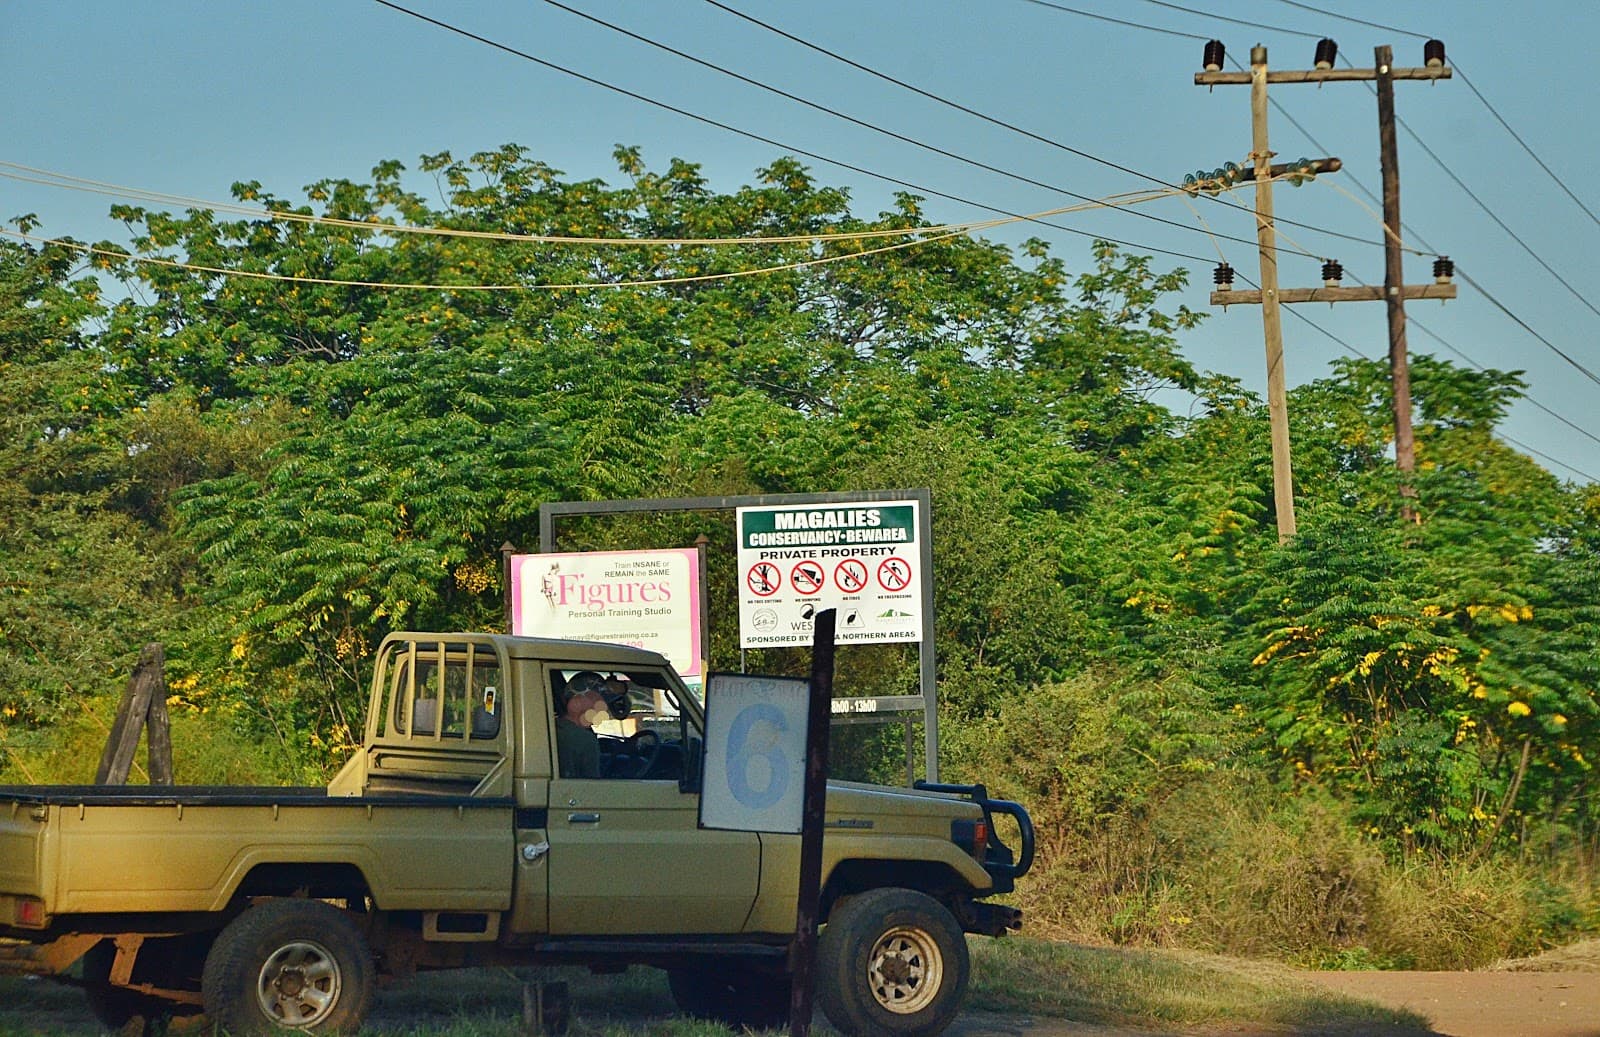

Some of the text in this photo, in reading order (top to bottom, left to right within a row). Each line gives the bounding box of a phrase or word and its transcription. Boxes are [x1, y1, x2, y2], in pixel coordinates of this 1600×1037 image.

[774, 509, 881, 530] MAGALIES
[760, 546, 897, 560] PRIVATE PROPERTY
[604, 570, 634, 578] REMAIN
[558, 573, 672, 611] Figures
[568, 607, 672, 618] Personal Training Studio
[746, 635, 797, 643] SPONSORED
[842, 632, 887, 640] NORTHERN
[888, 630, 916, 638] AREAS
[854, 699, 877, 713] 13h00
[726, 703, 789, 809] 6
